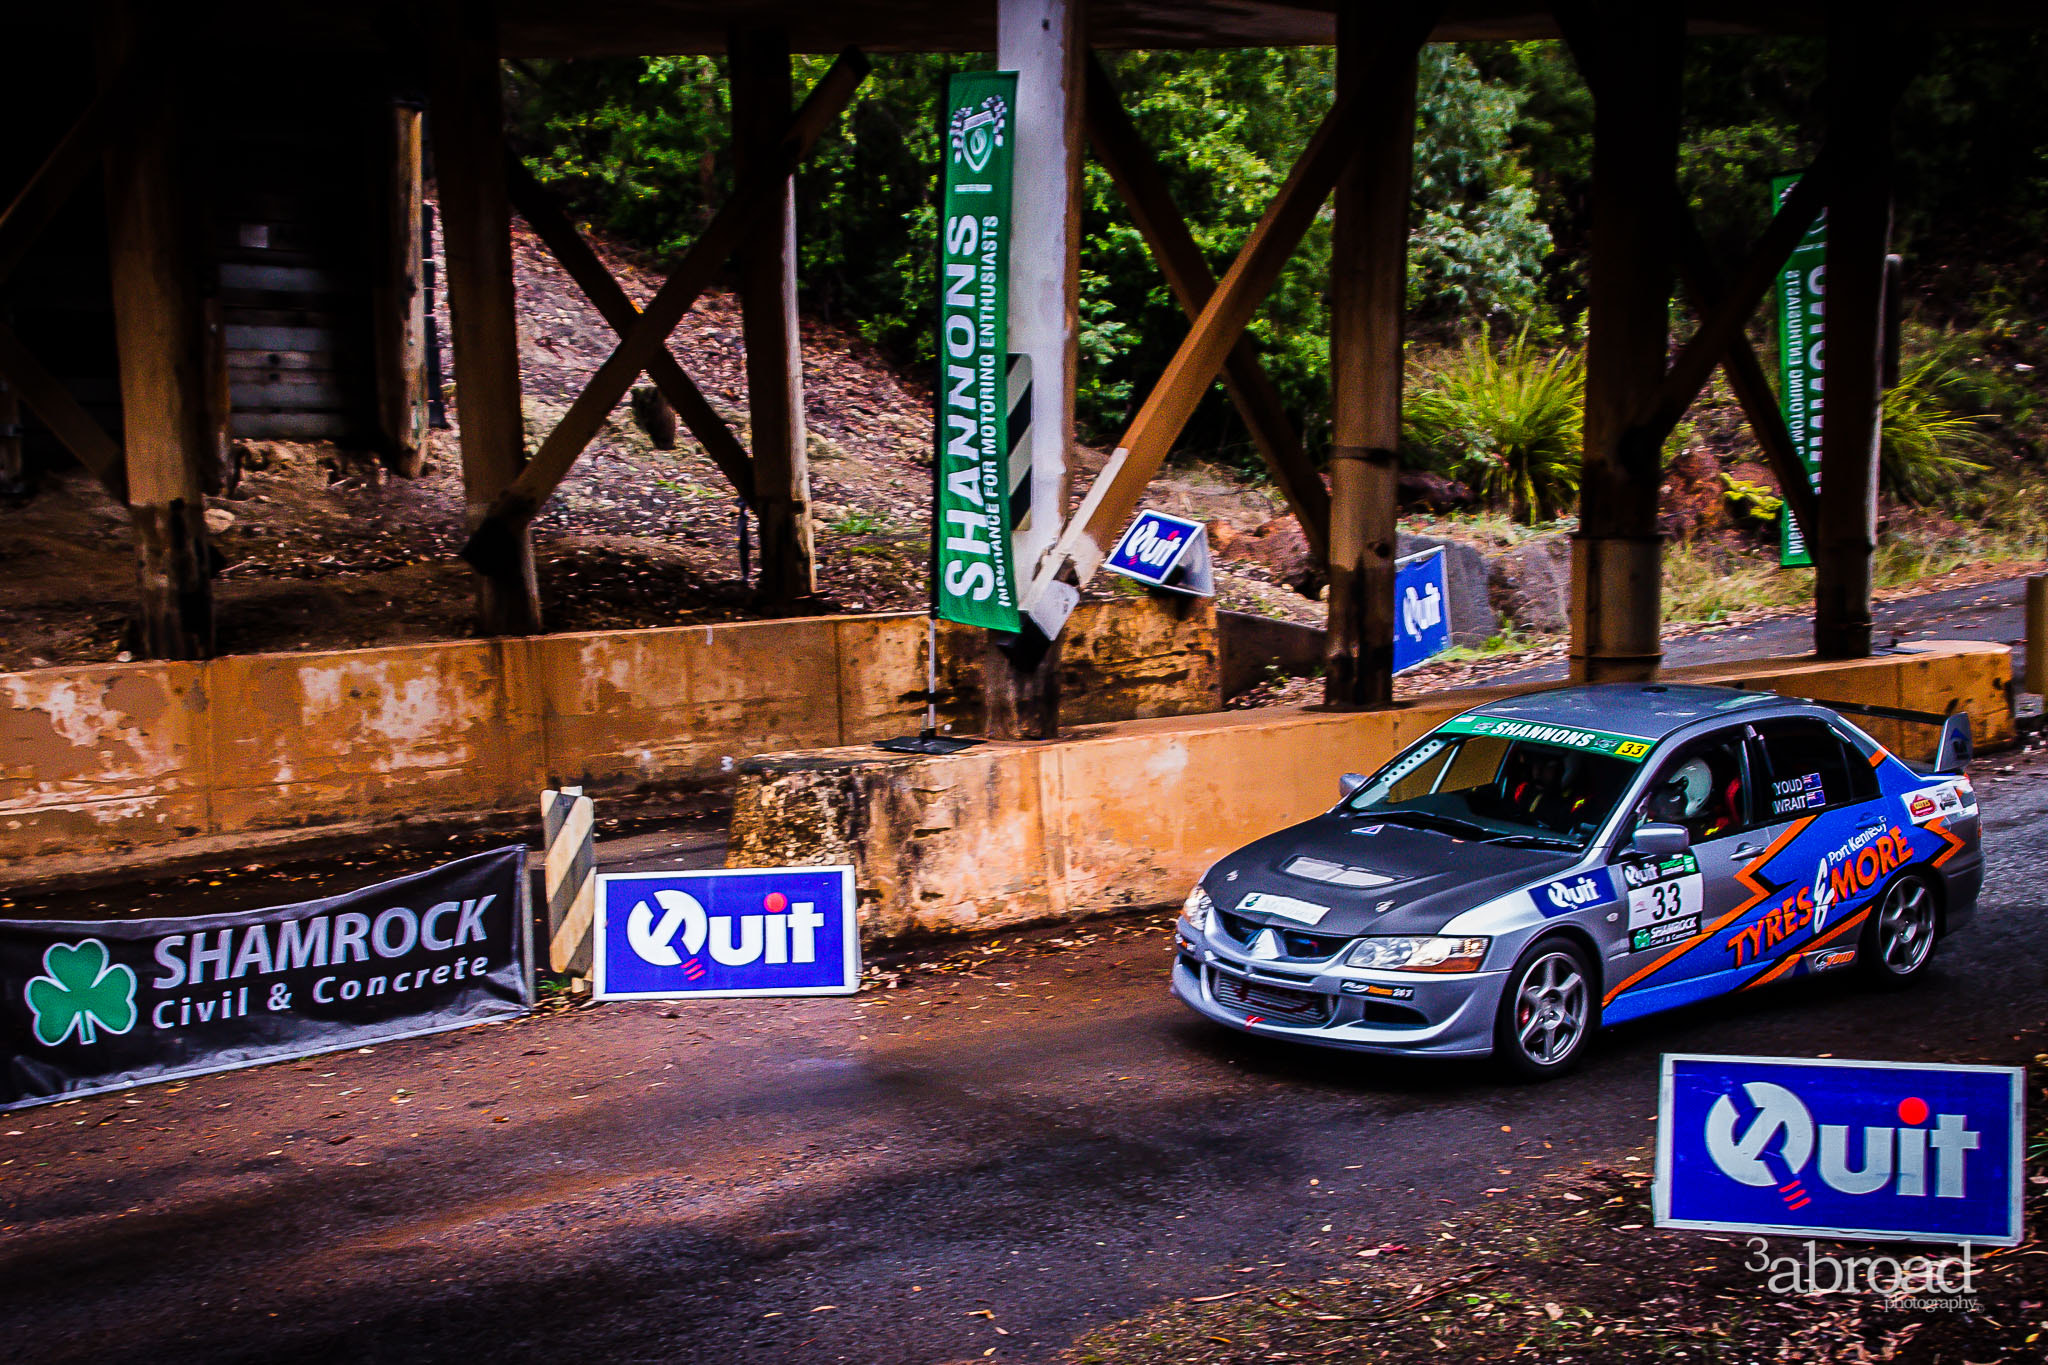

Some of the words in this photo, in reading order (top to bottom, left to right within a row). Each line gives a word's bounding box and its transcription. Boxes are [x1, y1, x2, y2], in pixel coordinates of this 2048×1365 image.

[979, 215, 999, 347] ENTHUSIASTS
[945, 213, 995, 602] SHANNONS
[979, 353, 998, 456] MOTORING
[982, 460, 999, 498] FOR
[1124, 520, 1182, 567] Quit
[1490, 721, 1596, 748] SHANNONS
[1621, 743, 1644, 756] 33
[1772, 778, 1803, 796] YOUD
[1772, 795, 1806, 814] WRAIT
[1625, 862, 1659, 887] Quit
[1828, 844, 1851, 866] Port
[1547, 876, 1600, 909] Quit
[1651, 882, 1681, 921] 33
[1727, 886, 1814, 967] TYRES
[1831, 825, 1914, 907] MORE
[152, 894, 497, 989] SHAMROCK
[626, 889, 825, 981] Quit
[152, 986, 248, 1030] Civil
[267, 982, 292, 1012] &
[312, 955, 489, 1004] Concrete
[1704, 1081, 1981, 1211] Quit
